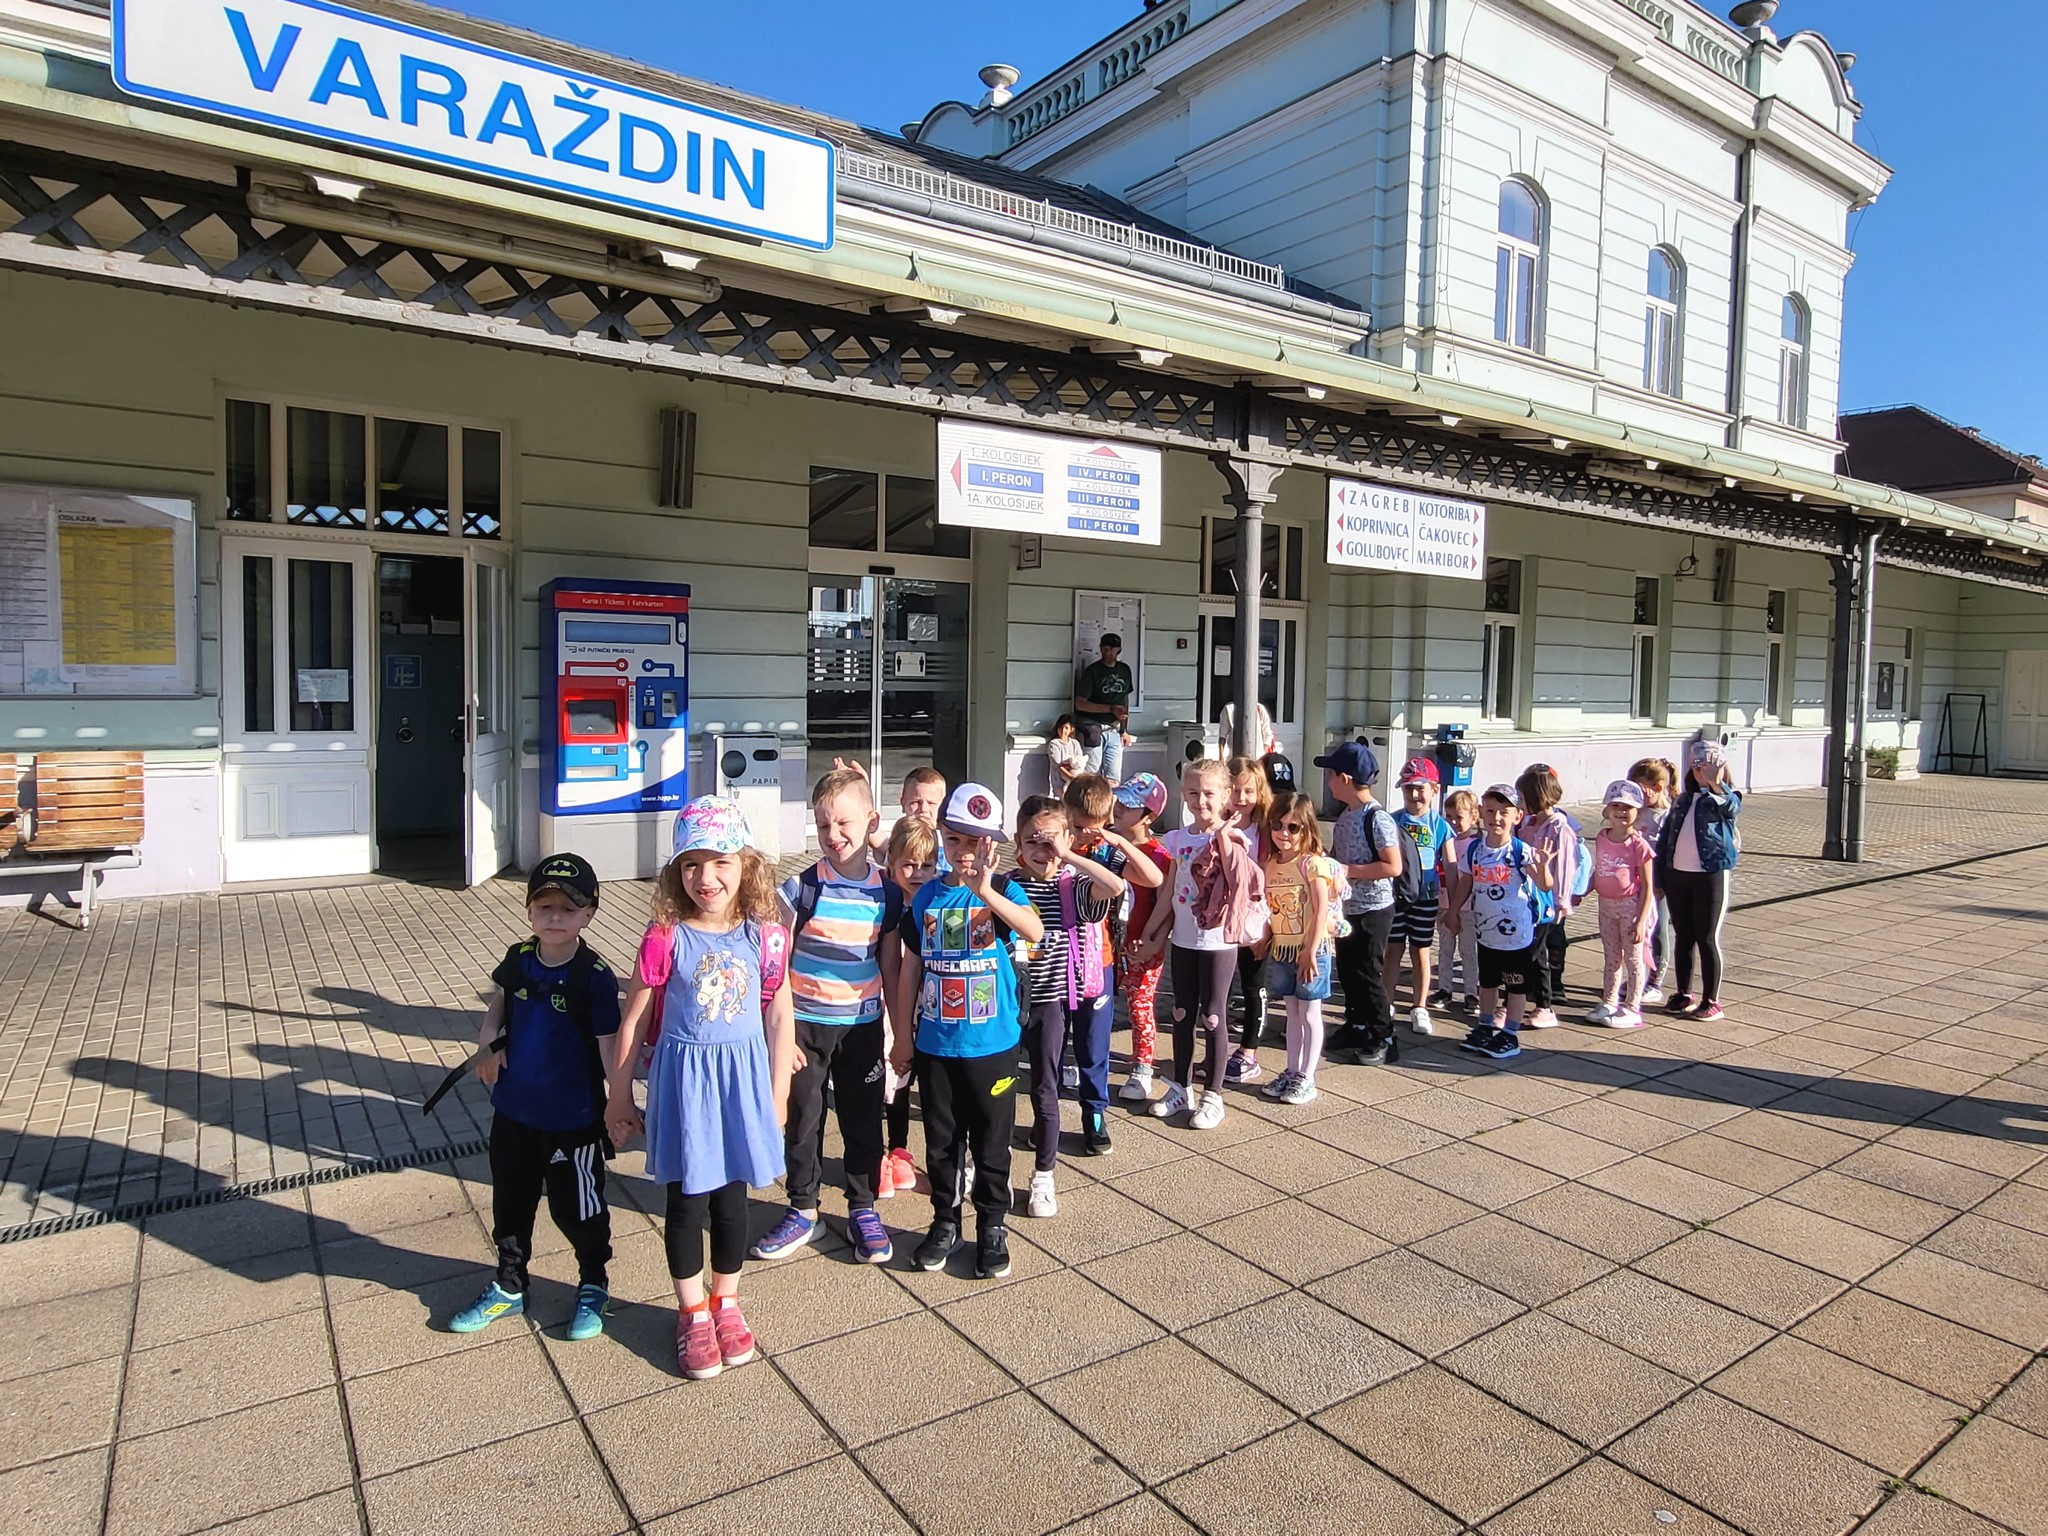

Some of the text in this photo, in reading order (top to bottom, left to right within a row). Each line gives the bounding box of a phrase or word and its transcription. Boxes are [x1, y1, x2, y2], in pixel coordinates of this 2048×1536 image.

[222, 6, 765, 210] VARAŽDIN
[982, 448, 1041, 467] KOLOSIJEK
[981, 471, 1032, 487] I. PERON
[1079, 467, 1131, 483] IV. PERON
[986, 494, 1044, 511] KOLOSIJEK
[1077, 493, 1131, 508] III. PERON
[1349, 490, 1409, 513] ZAGREB
[1419, 501, 1470, 522] KOTORIBA
[1079, 519, 1129, 533] II. PERON
[1347, 515, 1409, 538] KOPRIVNICA
[1418, 522, 1470, 546] ČAKOVEC
[1417, 550, 1469, 569] MARIBOR
[924, 957, 998, 973] MINECRAFT
